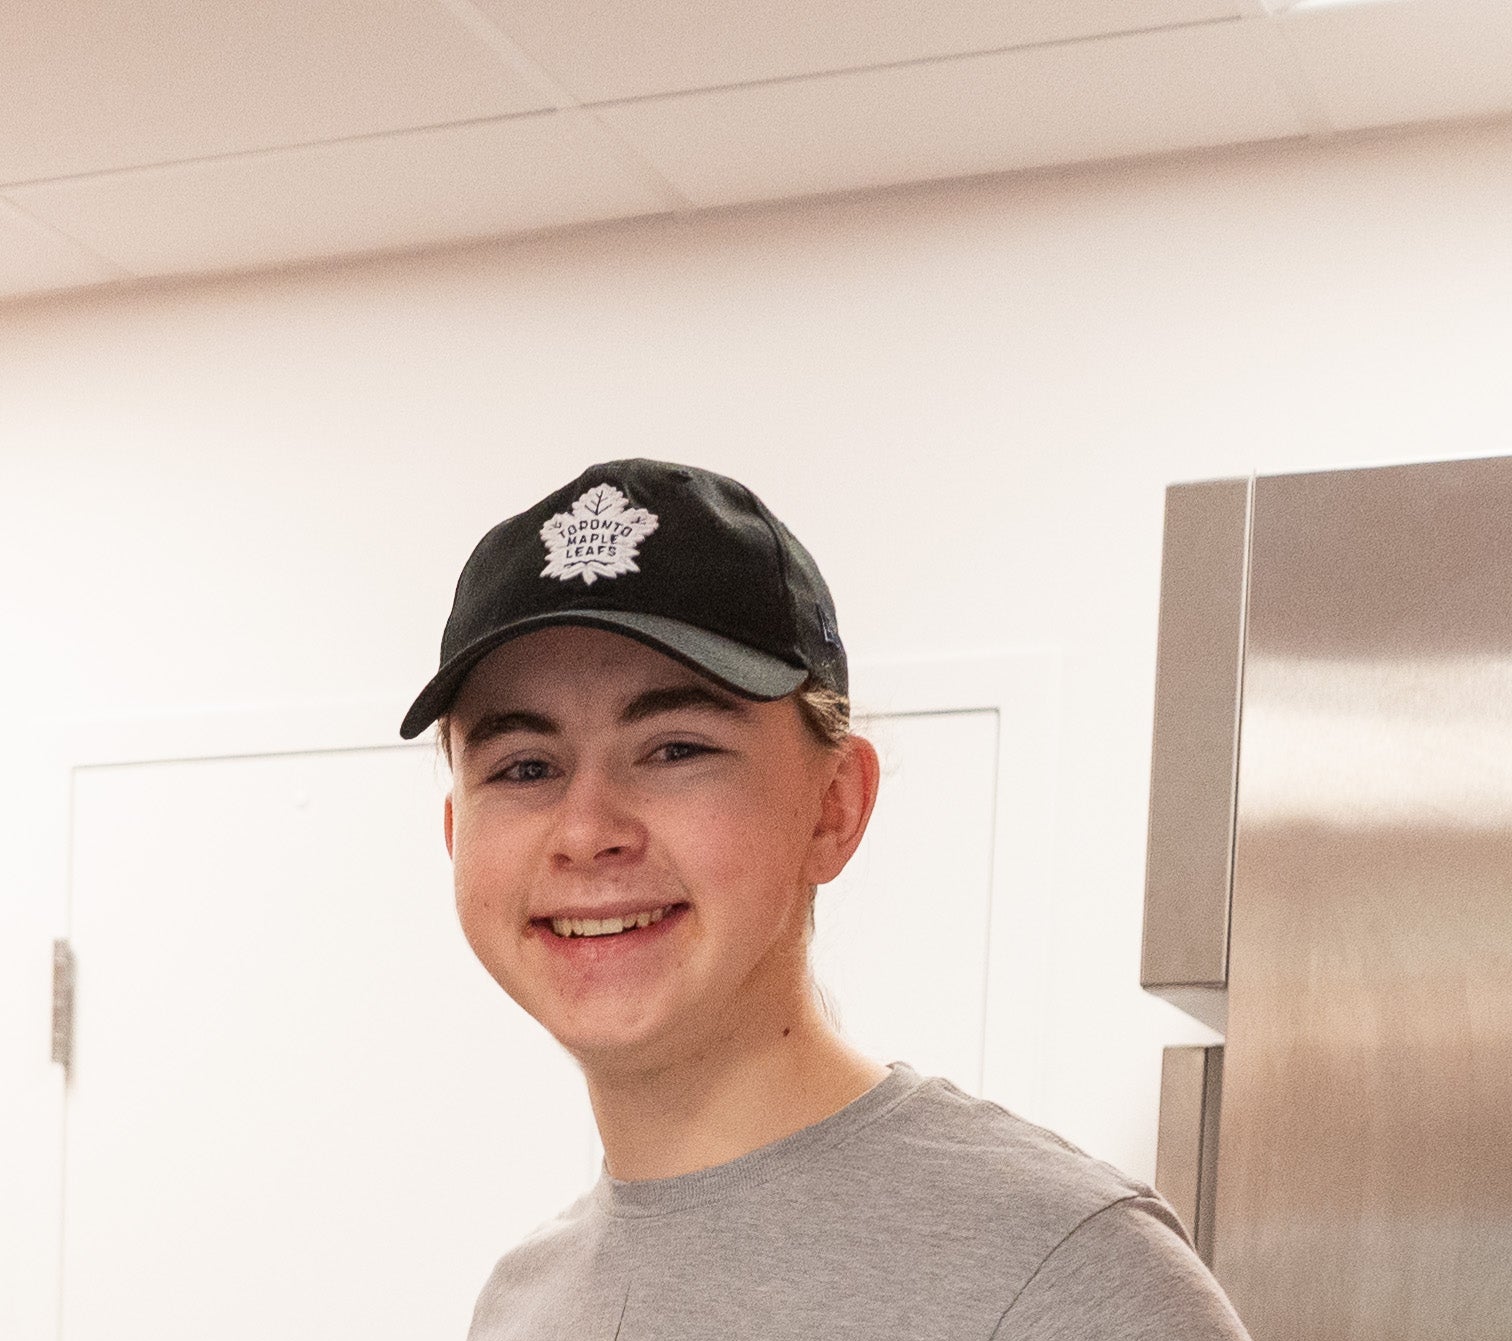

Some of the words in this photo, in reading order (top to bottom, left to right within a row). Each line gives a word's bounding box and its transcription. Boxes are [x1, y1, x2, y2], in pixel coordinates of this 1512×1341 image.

[559, 518, 633, 539] TORONTO
[567, 533, 619, 547] MAPLE
[566, 545, 617, 559] LEAFS
